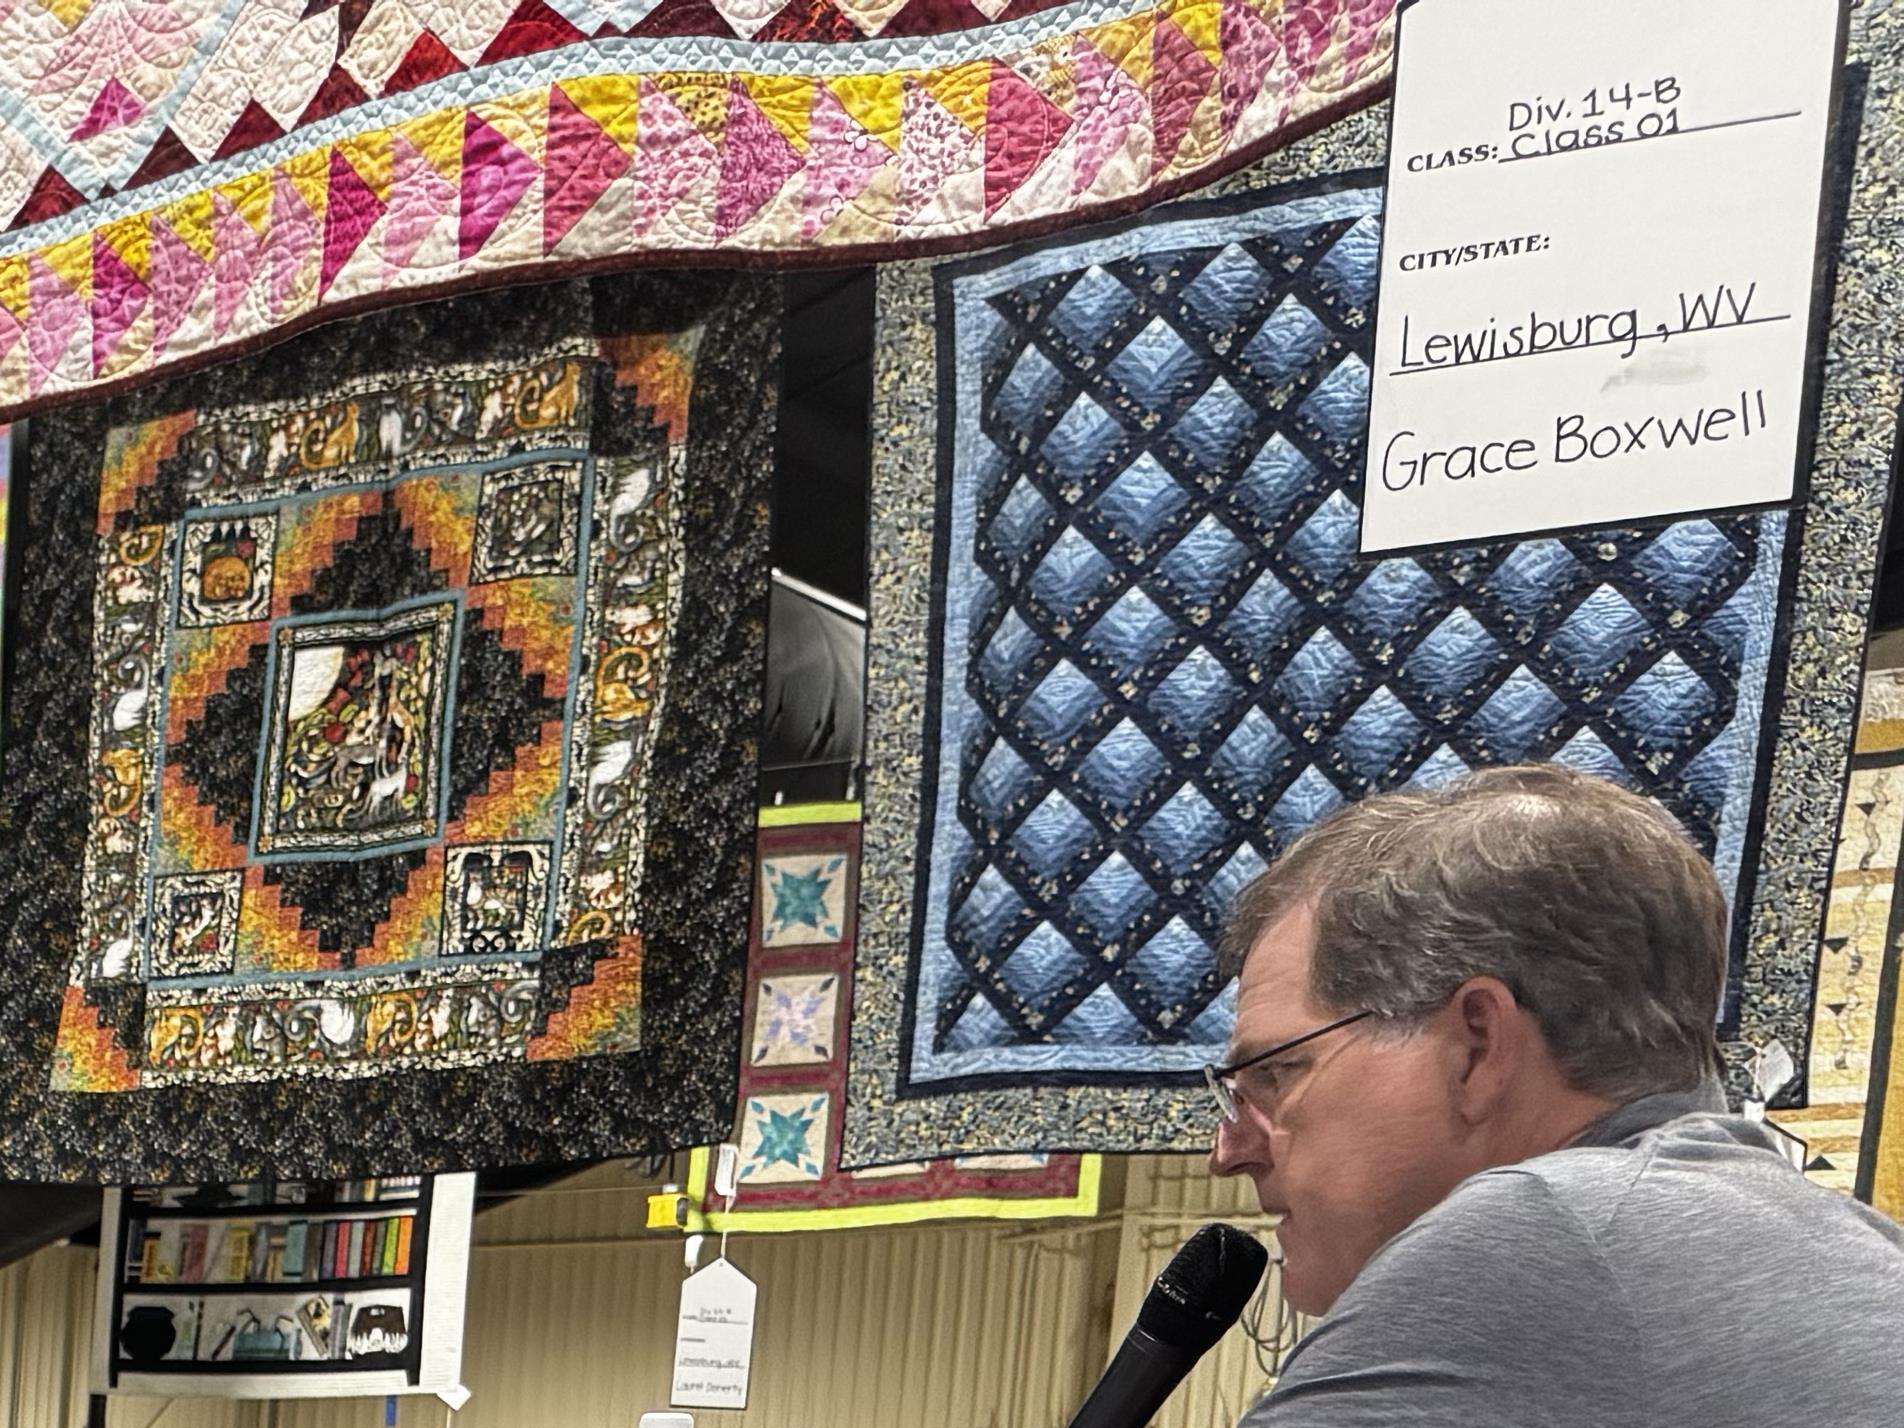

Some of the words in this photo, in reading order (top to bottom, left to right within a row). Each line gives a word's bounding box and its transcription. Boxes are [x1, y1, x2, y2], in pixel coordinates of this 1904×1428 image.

[1508, 95, 1574, 131] Div.
[1587, 76, 1682, 118] 14-B
[1406, 144, 1500, 174] CLASS:
[1511, 117, 1626, 160] Class
[1398, 234, 1551, 272] CITY/STATE:
[1382, 430, 1539, 491] Grace
[1553, 390, 1768, 464] Boxwell
